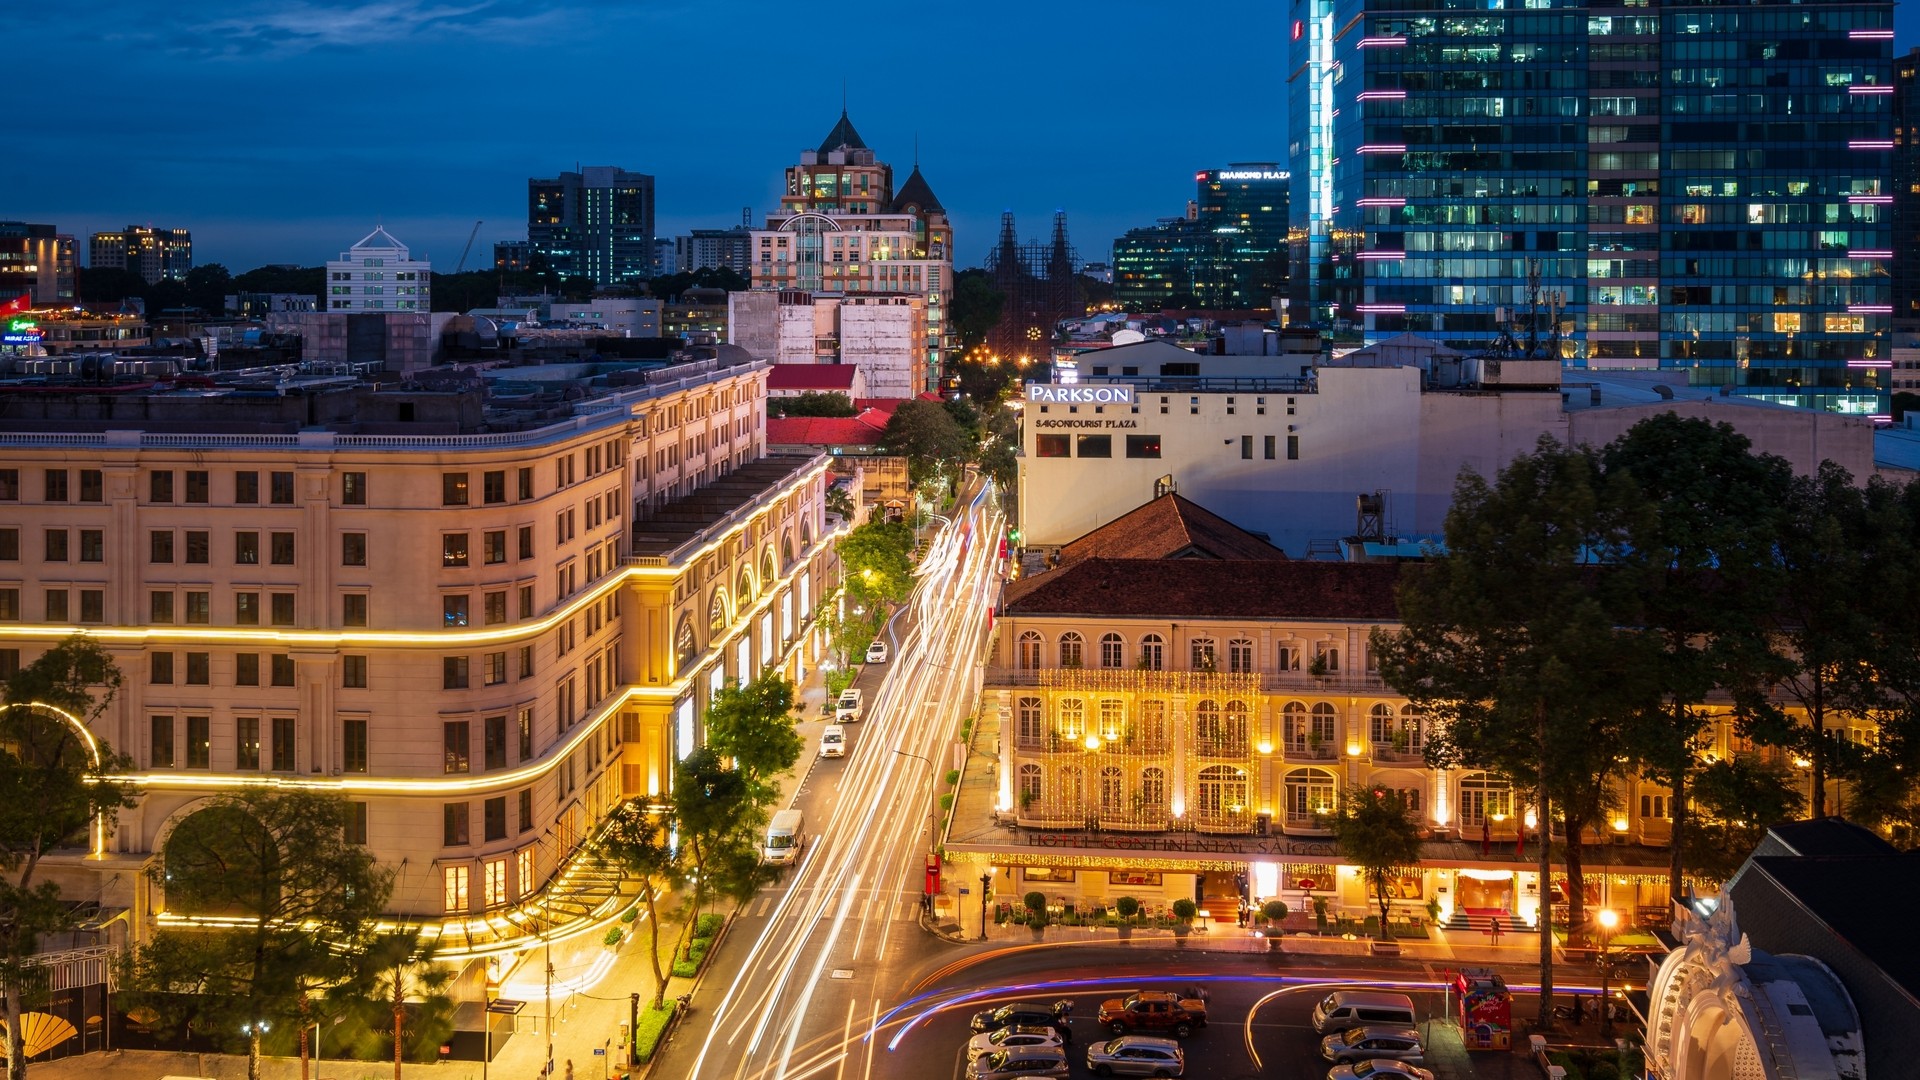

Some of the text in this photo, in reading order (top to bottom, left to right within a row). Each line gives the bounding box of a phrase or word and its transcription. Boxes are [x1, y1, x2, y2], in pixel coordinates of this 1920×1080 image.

[1031, 386, 1129, 402] PARKSON
[1036, 419, 1137, 429] SAIGONTOURIST PLAZA
[1029, 834, 1091, 848] HOTEL
[1104, 836, 1246, 853] CONTINENTAL
[389, 1029, 416, 1037] SON
